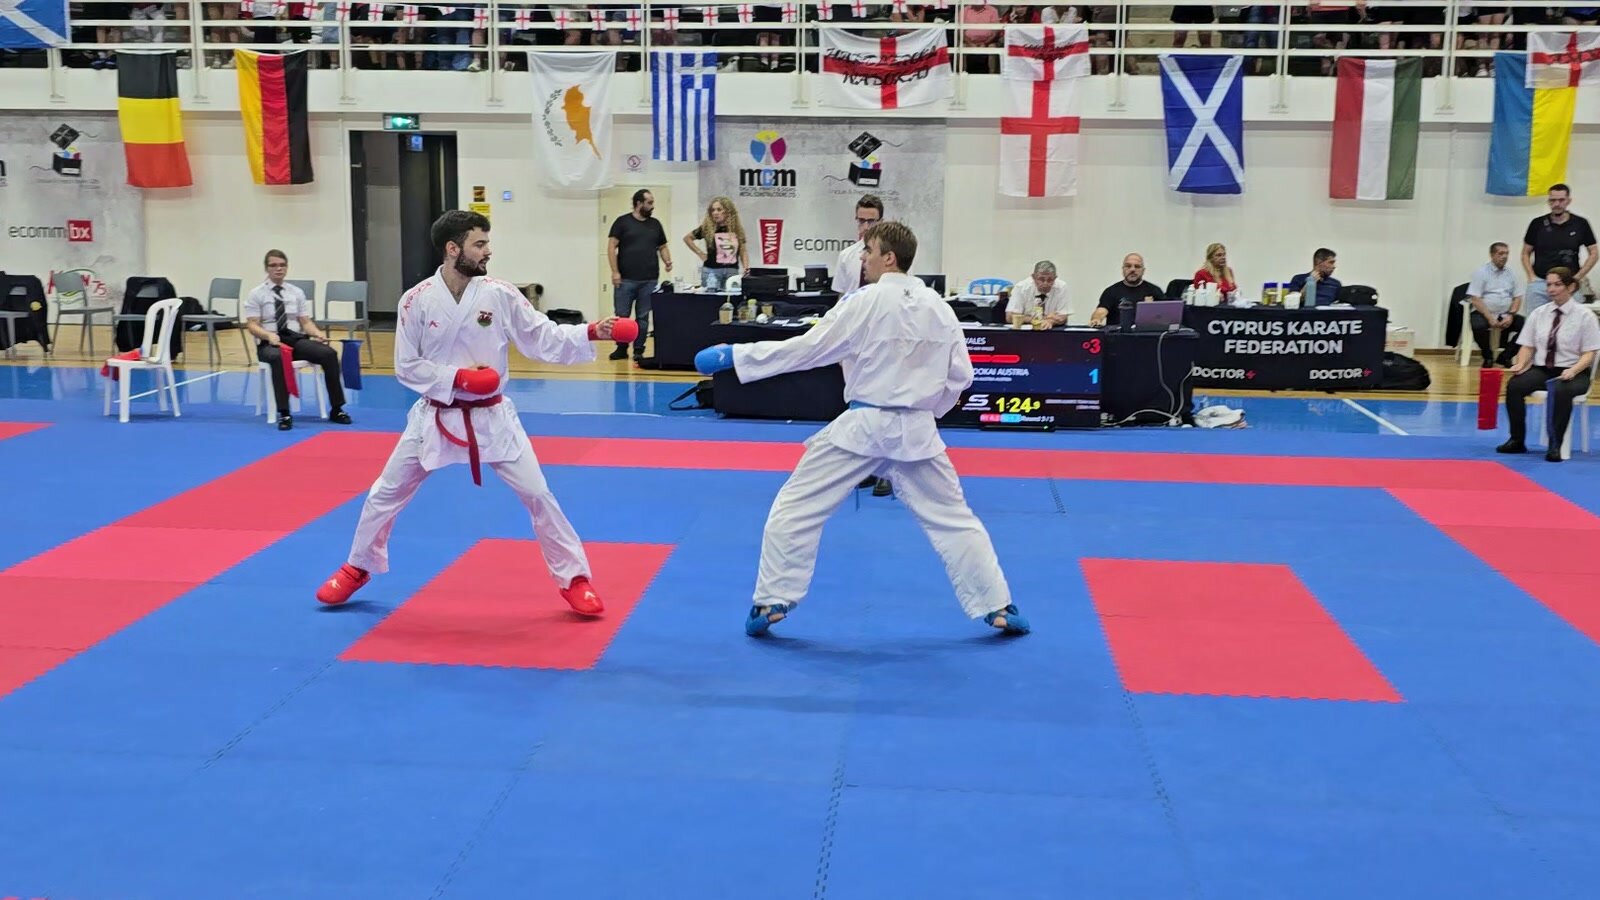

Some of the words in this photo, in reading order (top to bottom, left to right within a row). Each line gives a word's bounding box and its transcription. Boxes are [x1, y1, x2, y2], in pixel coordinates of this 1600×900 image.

[764, 223, 778, 252] Vittel
[1207, 320, 1284, 336] CYPRUS
[1288, 320, 1363, 335] KARATE
[1224, 340, 1343, 354] FEDERATION
[1089, 368, 1099, 384] 1
[1192, 367, 1245, 380] DOCTOR
[1309, 368, 1363, 380] DOCTOR
